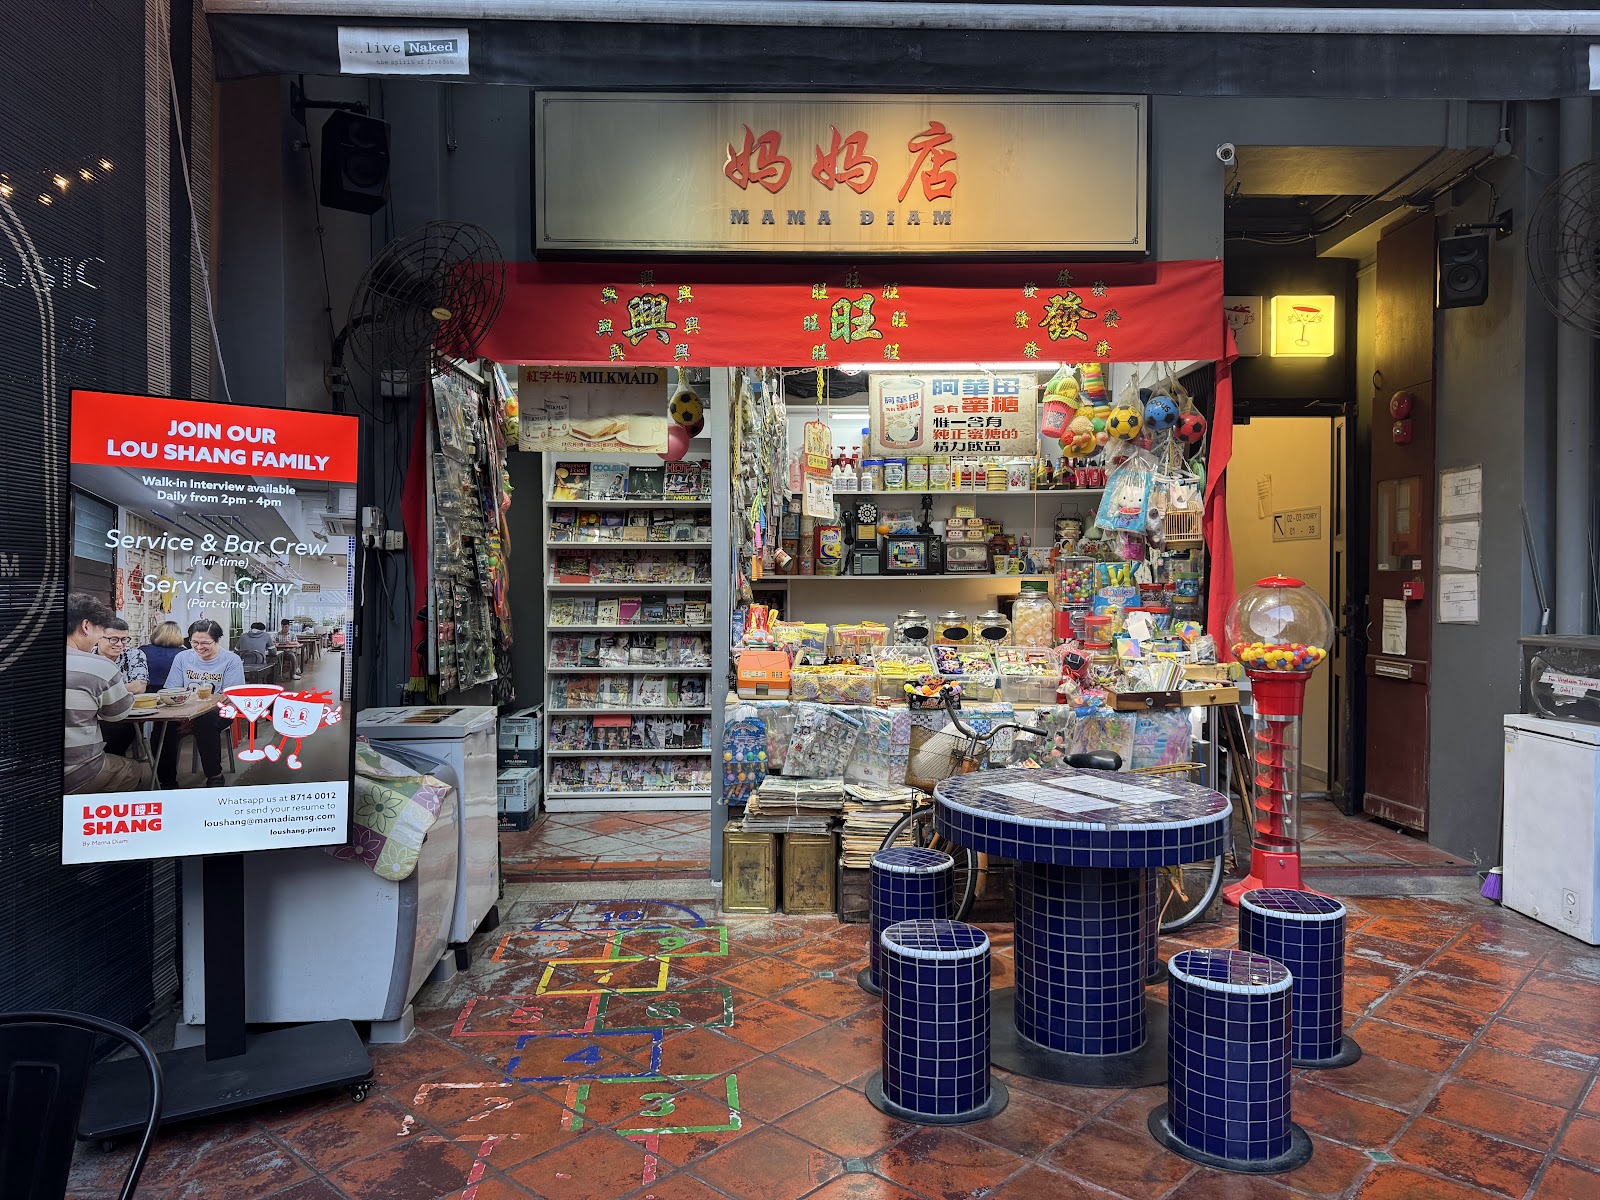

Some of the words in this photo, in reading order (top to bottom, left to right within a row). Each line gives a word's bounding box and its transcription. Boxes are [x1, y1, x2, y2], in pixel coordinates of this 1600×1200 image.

[408, 42, 454, 54] Naked
[722, 120, 957, 203] 妈妈店
[730, 210, 832, 225] MAMA
[860, 210, 952, 225] DIAM
[622, 292, 678, 346] 興
[829, 293, 883, 344] 旺
[1038, 291, 1098, 342] 發
[526, 370, 577, 384] 紅字牛奶
[579, 372, 659, 385] MILKMAID
[932, 378, 1020, 396] 阿華田
[168, 420, 222, 440] JOIN
[227, 424, 276, 444] OUR
[932, 428, 1018, 440] 純正蜜糖的
[933, 441, 1001, 452] 精力飲品
[107, 439, 158, 458] LOU
[164, 444, 247, 466] SHANG
[252, 450, 330, 472] FAMILY
[142, 476, 188, 490] Walk-in
[190, 478, 245, 492] Interview
[247, 482, 296, 495] available
[157, 491, 188, 504] Daily
[190, 492, 218, 504] from
[220, 494, 247, 506] 2pm
[256, 496, 282, 507] 4pm
[105, 529, 194, 552] Service
[200, 533, 218, 552] &
[224, 534, 264, 553] Bar
[270, 536, 328, 556] Crew
[190, 555, 250, 570] (Full-time)
[142, 574, 228, 595] Service
[234, 577, 293, 597] Crew
[186, 598, 250, 611] (Part-time)
[218, 796, 264, 806] Whatsapp
[278, 794, 288, 802] at
[290, 793, 313, 802] 8714
[314, 792, 336, 800] 0012
[82, 804, 129, 820] LOU
[246, 806, 268, 814] send
[270, 806, 292, 816] your
[294, 804, 326, 812] resume
[82, 818, 162, 836] SHANG
[204, 813, 336, 828] loushang@mamadiamsg.com
[270, 826, 336, 836] loushang.prinsep
[82, 840, 90, 848] By
[112, 838, 128, 846] Diam
[599, 909, 645, 922] 10
[658, 936, 686, 949] 9
[593, 970, 614, 984] 7
[508, 1006, 544, 1024] 5
[646, 1002, 681, 1020] 6
[562, 1046, 603, 1066] 4
[640, 1092, 676, 1117] 3
